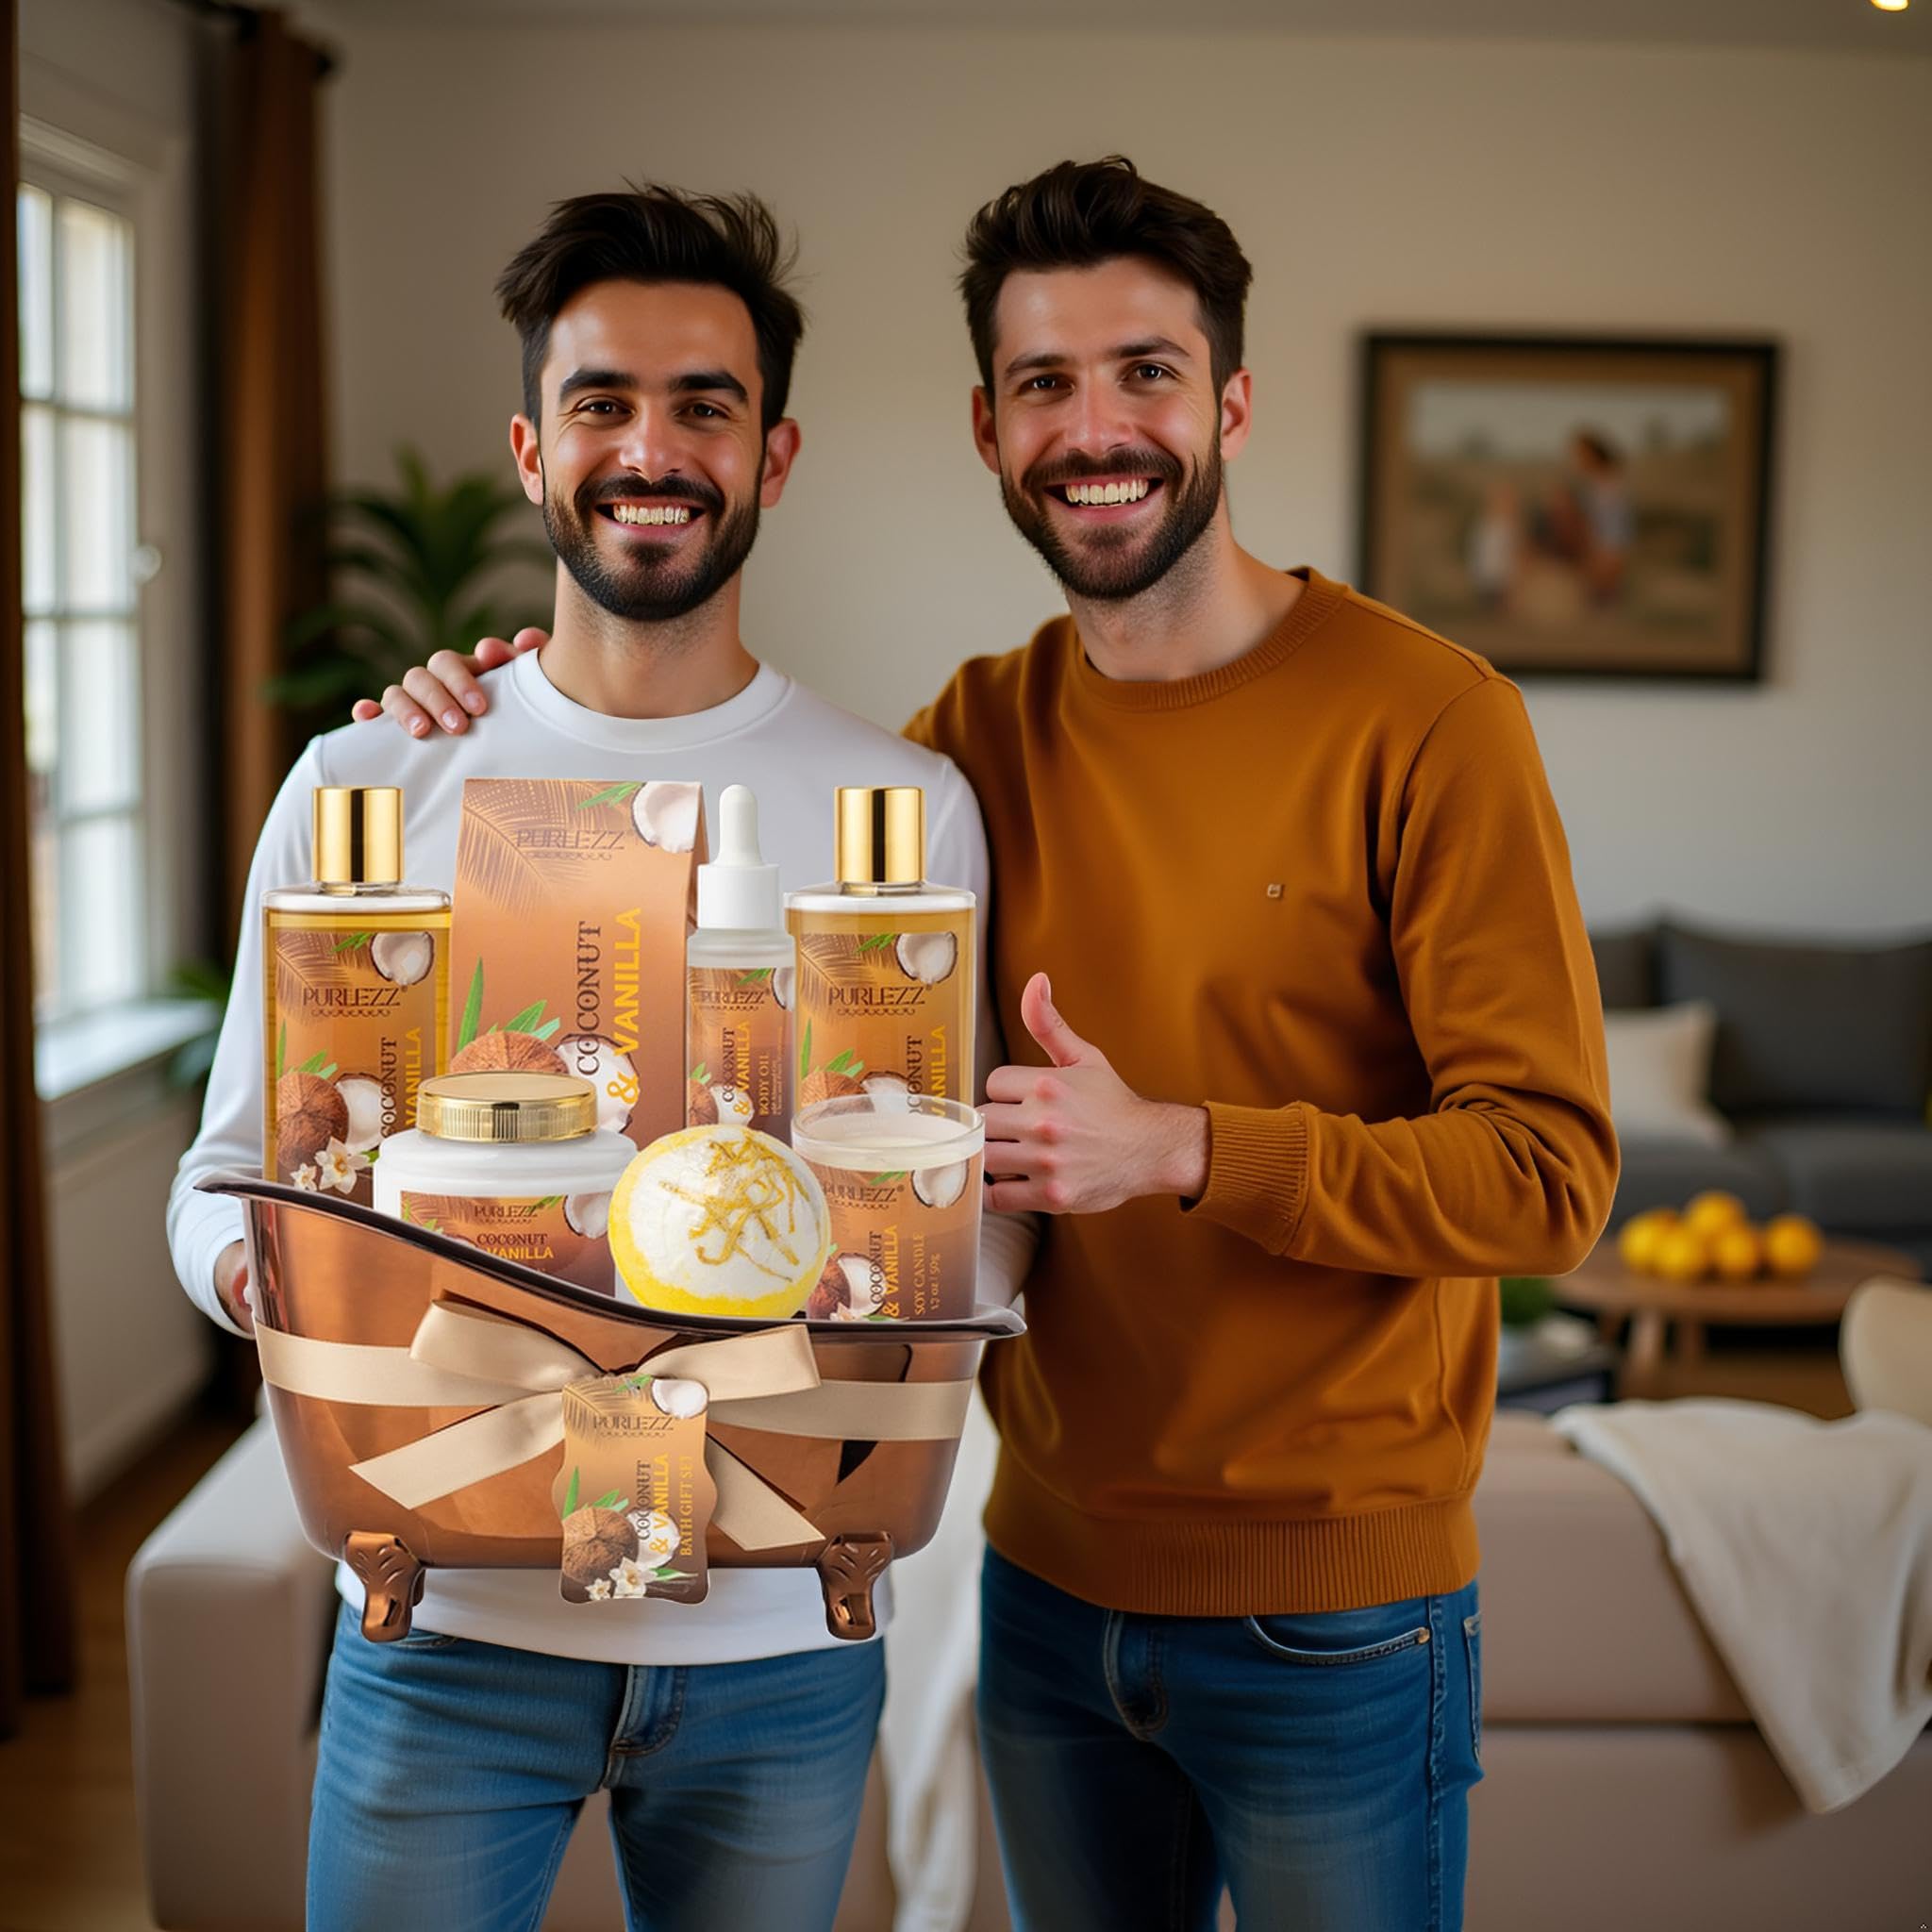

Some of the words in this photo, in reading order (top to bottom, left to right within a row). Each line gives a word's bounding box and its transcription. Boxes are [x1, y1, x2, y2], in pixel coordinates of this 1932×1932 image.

[516, 829, 625, 850] PURLEZZ
[303, 987, 400, 1008] PURLEZZ
[576, 921, 602, 1075] COCONUT
[614, 908, 641, 1058] VANILLA
[700, 991, 765, 1005] PURLEZZ
[828, 986, 925, 1006] PURLEZZ
[722, 1026, 736, 1103] COCONUT
[736, 1021, 751, 1092] VANILLA
[758, 1053, 770, 1075] OIL
[380, 1037, 396, 1139] COCONUT
[607, 1072, 639, 1105] &
[907, 1035, 923, 1114] CONUT
[733, 1100, 750, 1116] &
[758, 1078, 770, 1116] BODY
[475, 1205, 539, 1218] PURLEZZ
[476, 1233, 548, 1246] COCONUT
[869, 1230, 883, 1305] COCONUT
[883, 1224, 899, 1296] VANILLA
[912, 1231, 925, 1288] CANDLE
[882, 1301, 900, 1318] &
[913, 1290, 925, 1316] SOY
[593, 1415, 674, 1431] PURLEZZ
[679, 1455, 693, 1479] SET
[637, 1459, 651, 1541] COCONUT
[652, 1453, 670, 1530] VANILLA
[679, 1481, 693, 1516] GIFT
[649, 1537, 669, 1556] &
[679, 1519, 693, 1557] BATH
